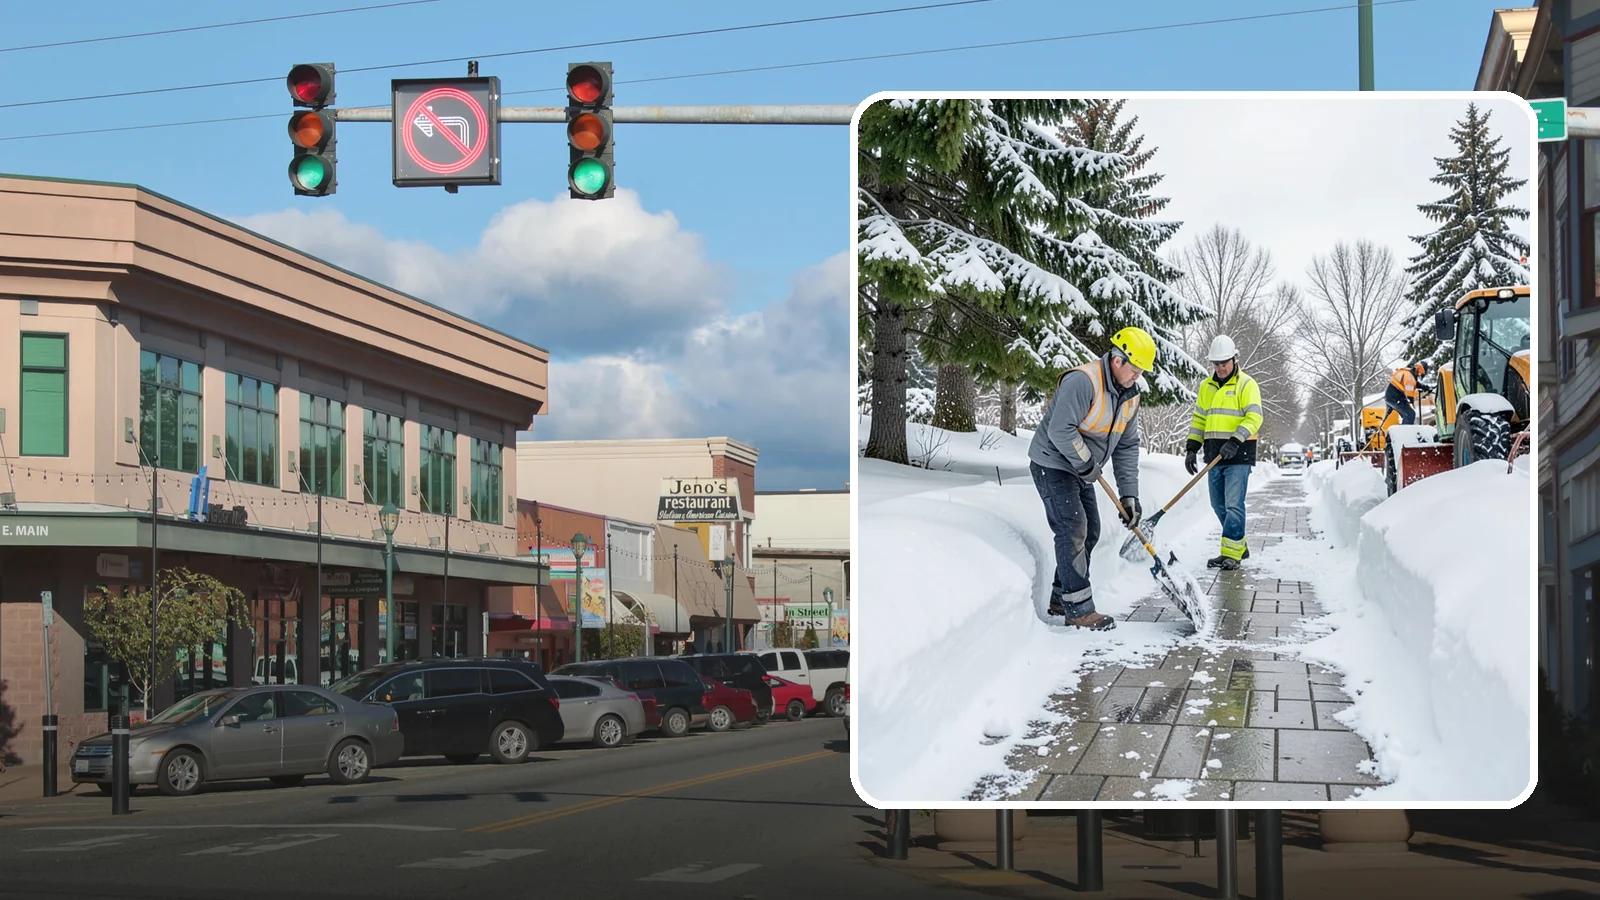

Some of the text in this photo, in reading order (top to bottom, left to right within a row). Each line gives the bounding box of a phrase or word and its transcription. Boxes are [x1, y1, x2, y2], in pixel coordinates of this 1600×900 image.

[670, 480, 727, 495] Jeno's
[665, 496, 731, 509] restaurant
[658, 510, 681, 519] Italian
[686, 509, 714, 519] American
[715, 509, 737, 519] Cuisine
[2, 525, 49, 536] E. MAIN
[797, 607, 829, 617] Street
